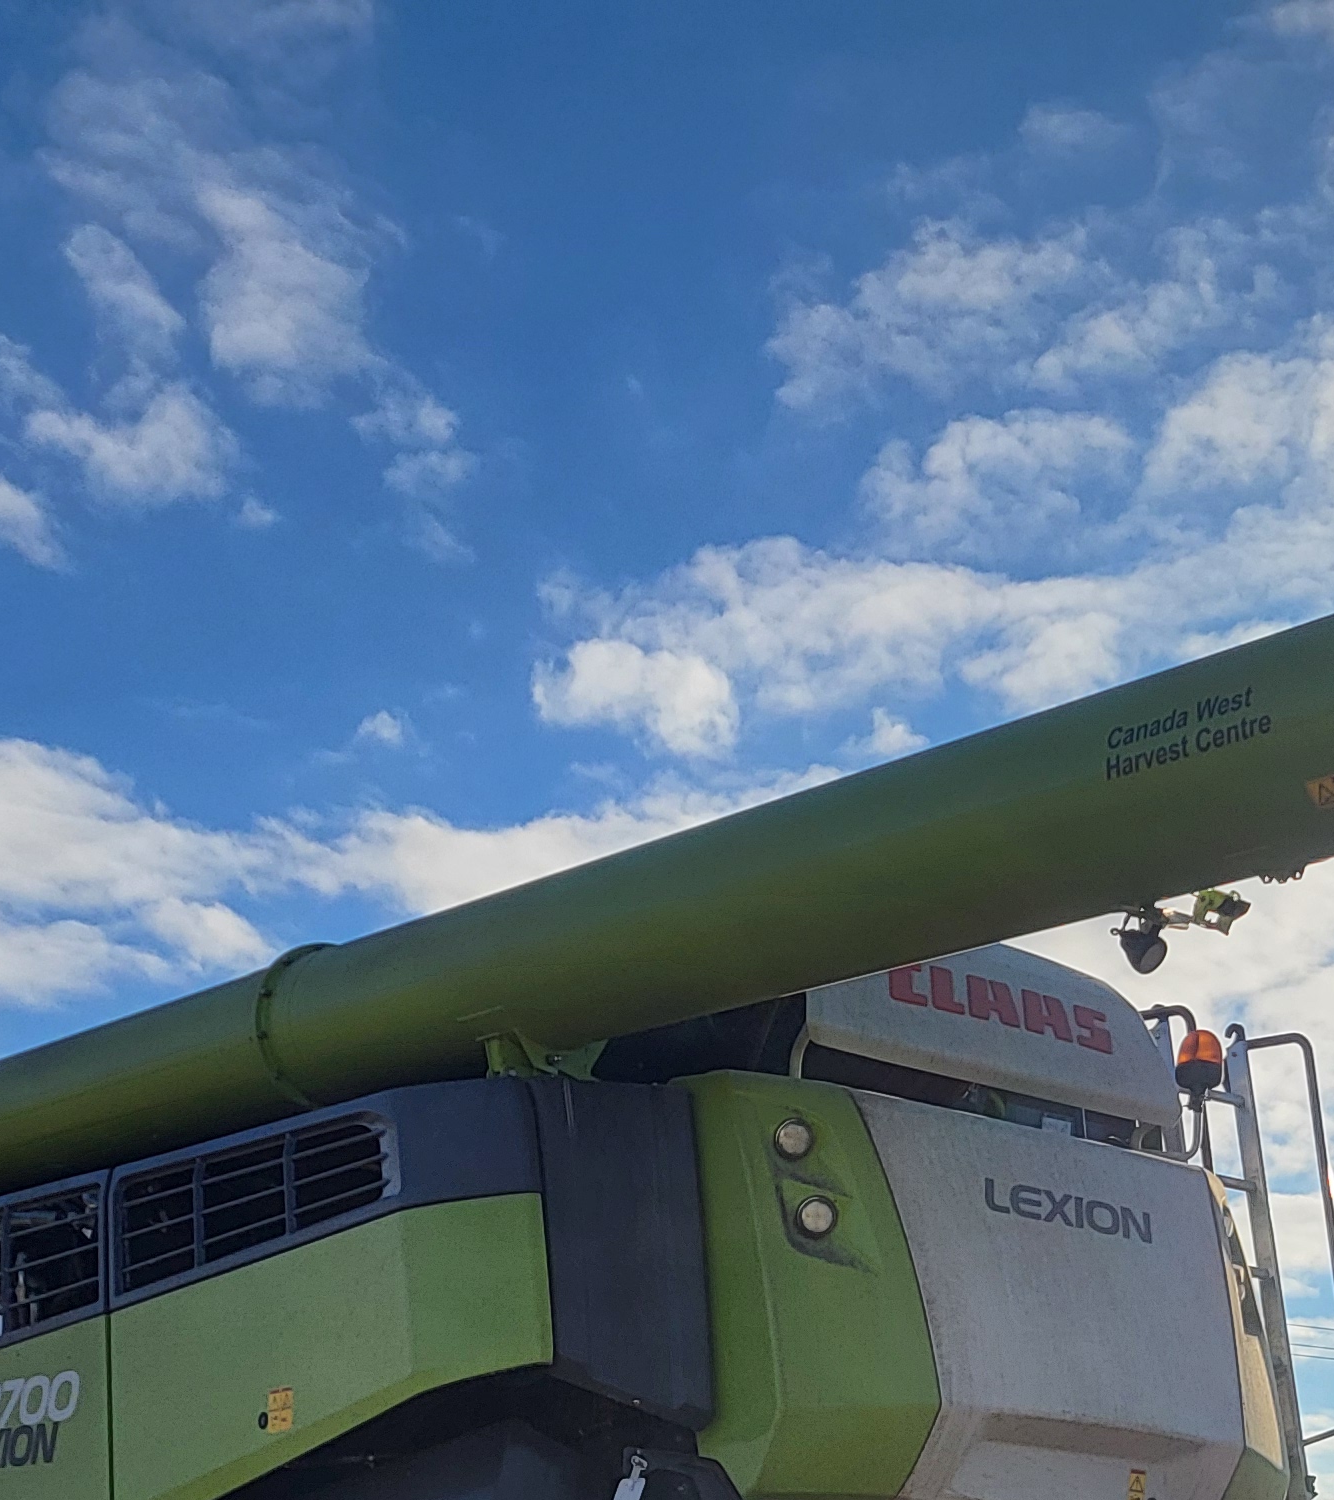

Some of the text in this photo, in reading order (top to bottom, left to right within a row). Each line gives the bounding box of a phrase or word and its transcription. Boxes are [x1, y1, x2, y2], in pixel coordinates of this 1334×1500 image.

[1105, 714, 1272, 780] Harvest Centre
[1107, 686, 1253, 749] Canada West
[888, 965, 1114, 1055] CLAAS
[983, 1177, 1153, 1244] LEXION
